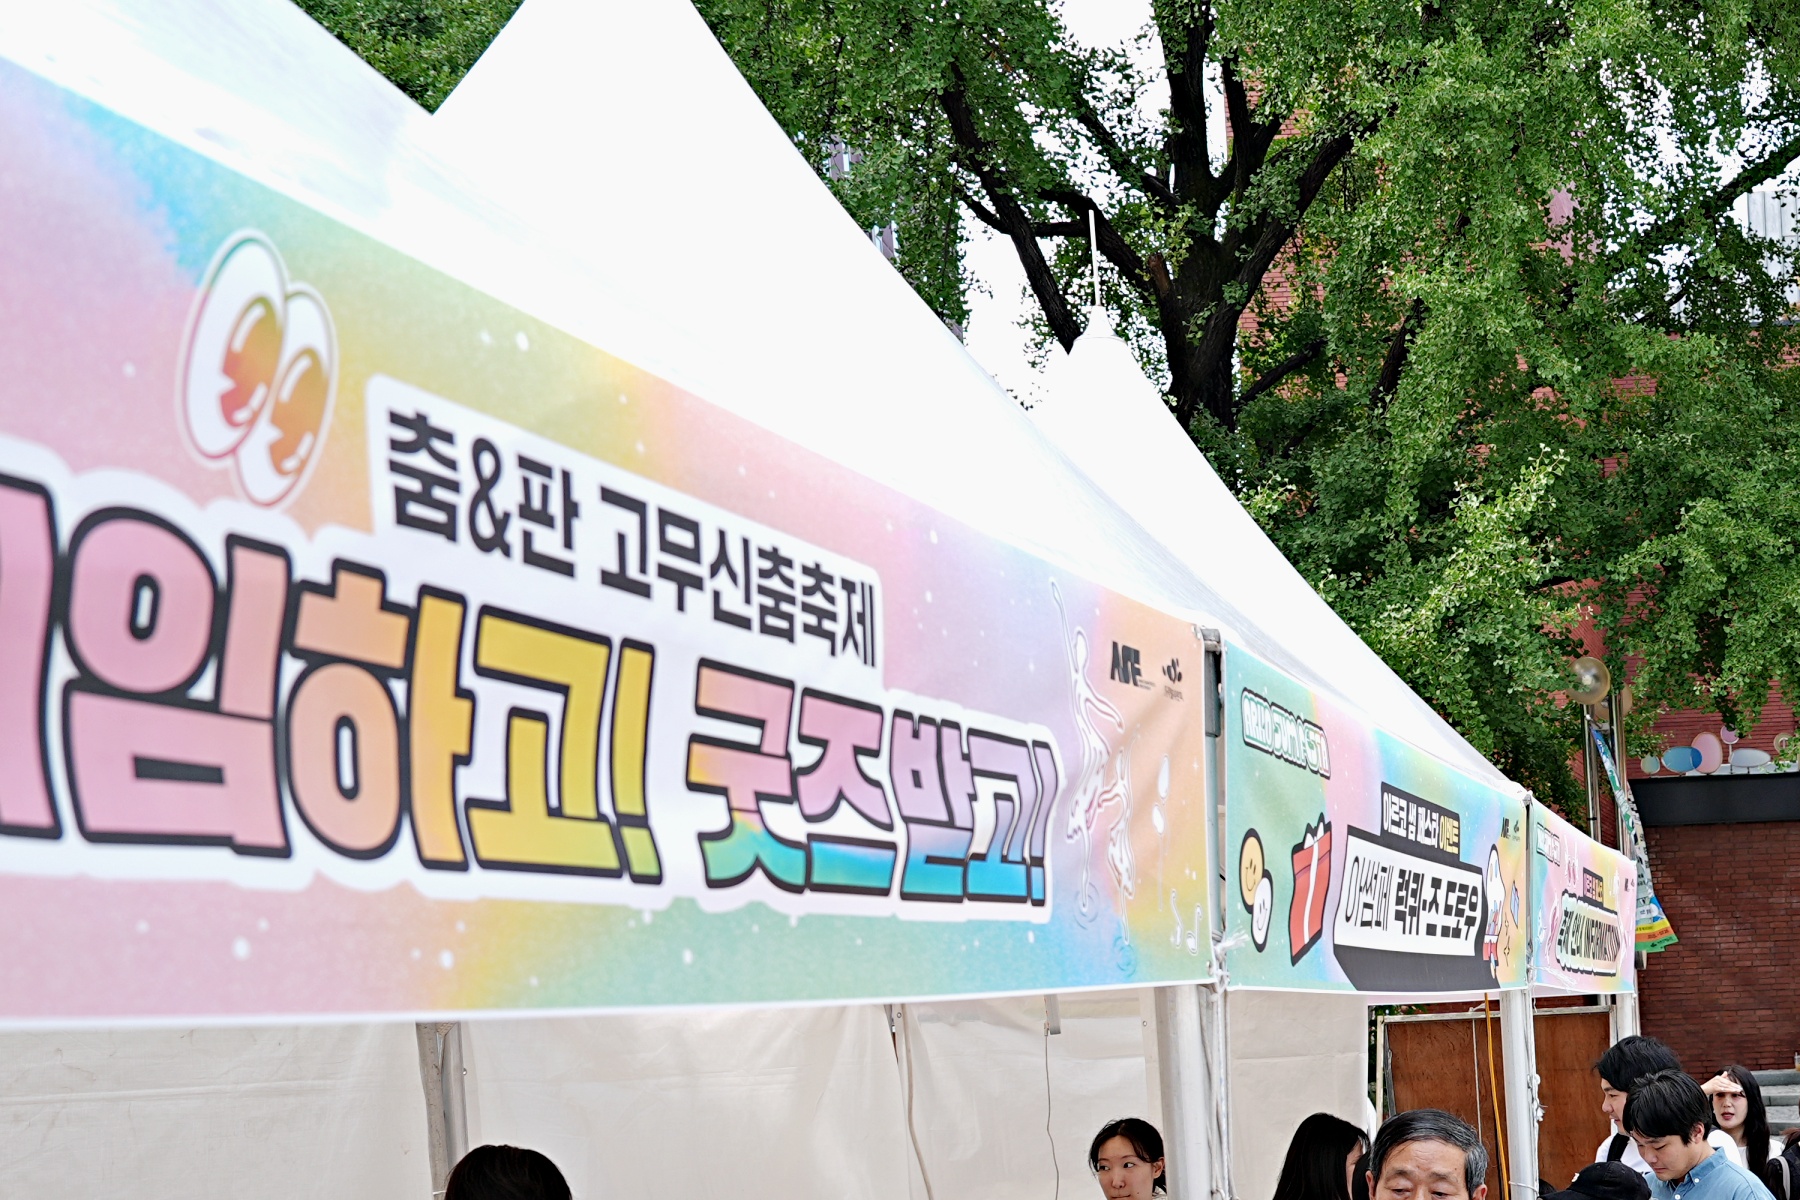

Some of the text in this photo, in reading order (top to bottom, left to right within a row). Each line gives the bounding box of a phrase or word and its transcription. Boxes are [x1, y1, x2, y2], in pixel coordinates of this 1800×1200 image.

[388, 410, 877, 668] 춤&판 고무신춤축제
[686, 659, 1059, 907] 굿즈받고!
[1383, 792, 1459, 855] 아르코 썸 페스타 이벤트
[1345, 855, 1394, 931] 아썸페
[1441, 880, 1479, 941] 드로우
